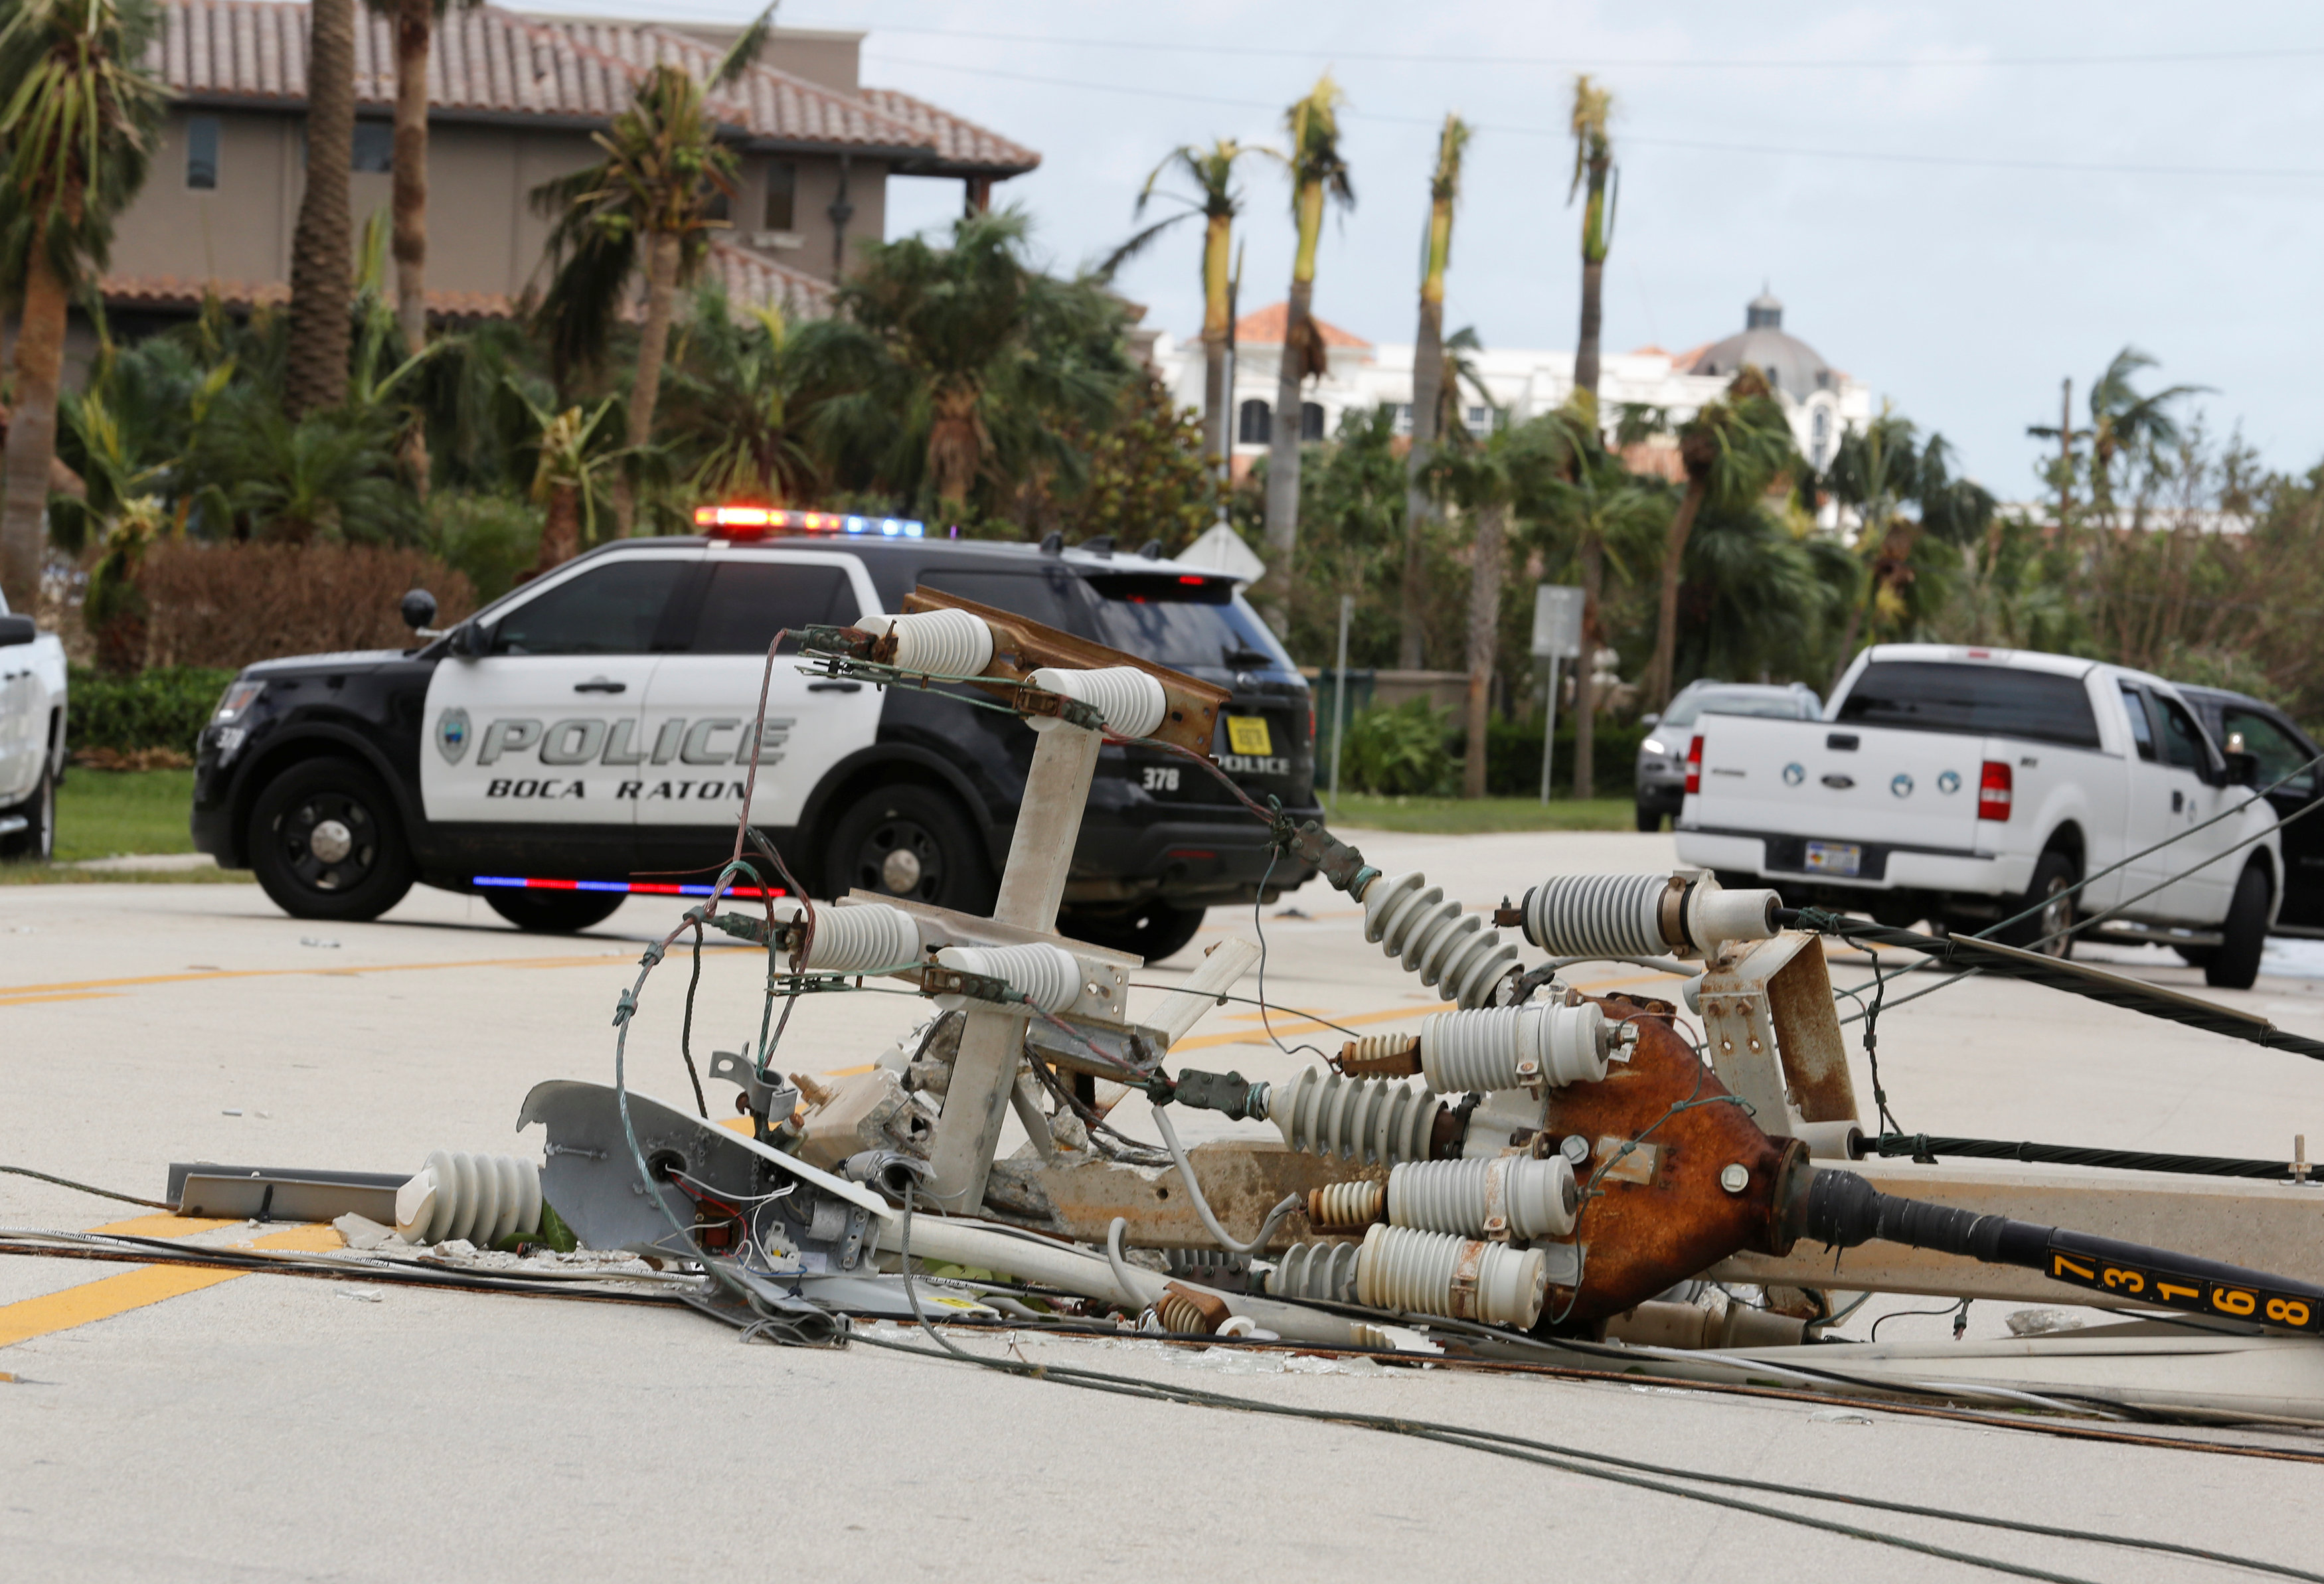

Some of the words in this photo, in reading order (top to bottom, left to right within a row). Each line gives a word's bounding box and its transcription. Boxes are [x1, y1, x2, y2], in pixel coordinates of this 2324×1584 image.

[477, 718, 795, 765] POLICE
[486, 779, 584, 798] BOCA
[616, 781, 753, 799] RATON
[1143, 767, 1179, 791] 378
